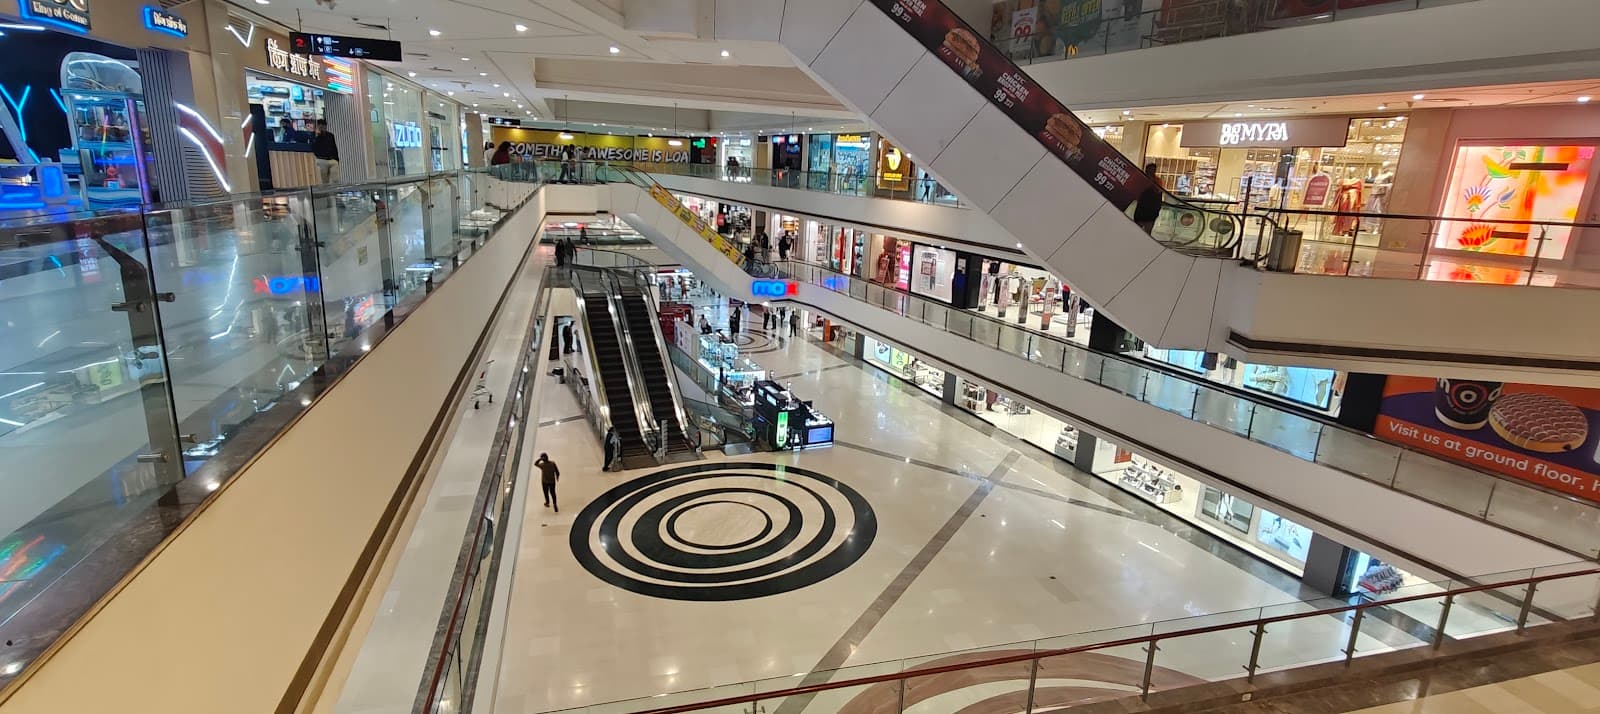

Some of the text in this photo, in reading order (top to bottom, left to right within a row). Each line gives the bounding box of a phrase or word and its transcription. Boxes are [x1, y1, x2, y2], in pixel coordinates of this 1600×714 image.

[891, 3, 904, 17] 99
[267, 38, 290, 72] किंग
[1002, 72, 1030, 97] CHICKEN
[993, 89, 1007, 103] 99
[587, 147, 649, 161] AWESOME
[651, 150, 662, 162] IS
[1103, 156, 1131, 180] CHICKEN
[1094, 172, 1107, 185] 99
[1390, 420, 1420, 439] Visit
[1423, 433, 1441, 445] us
[1444, 439, 1462, 451] at
[1465, 445, 1529, 471] ground
[1533, 463, 1585, 490] floor,
